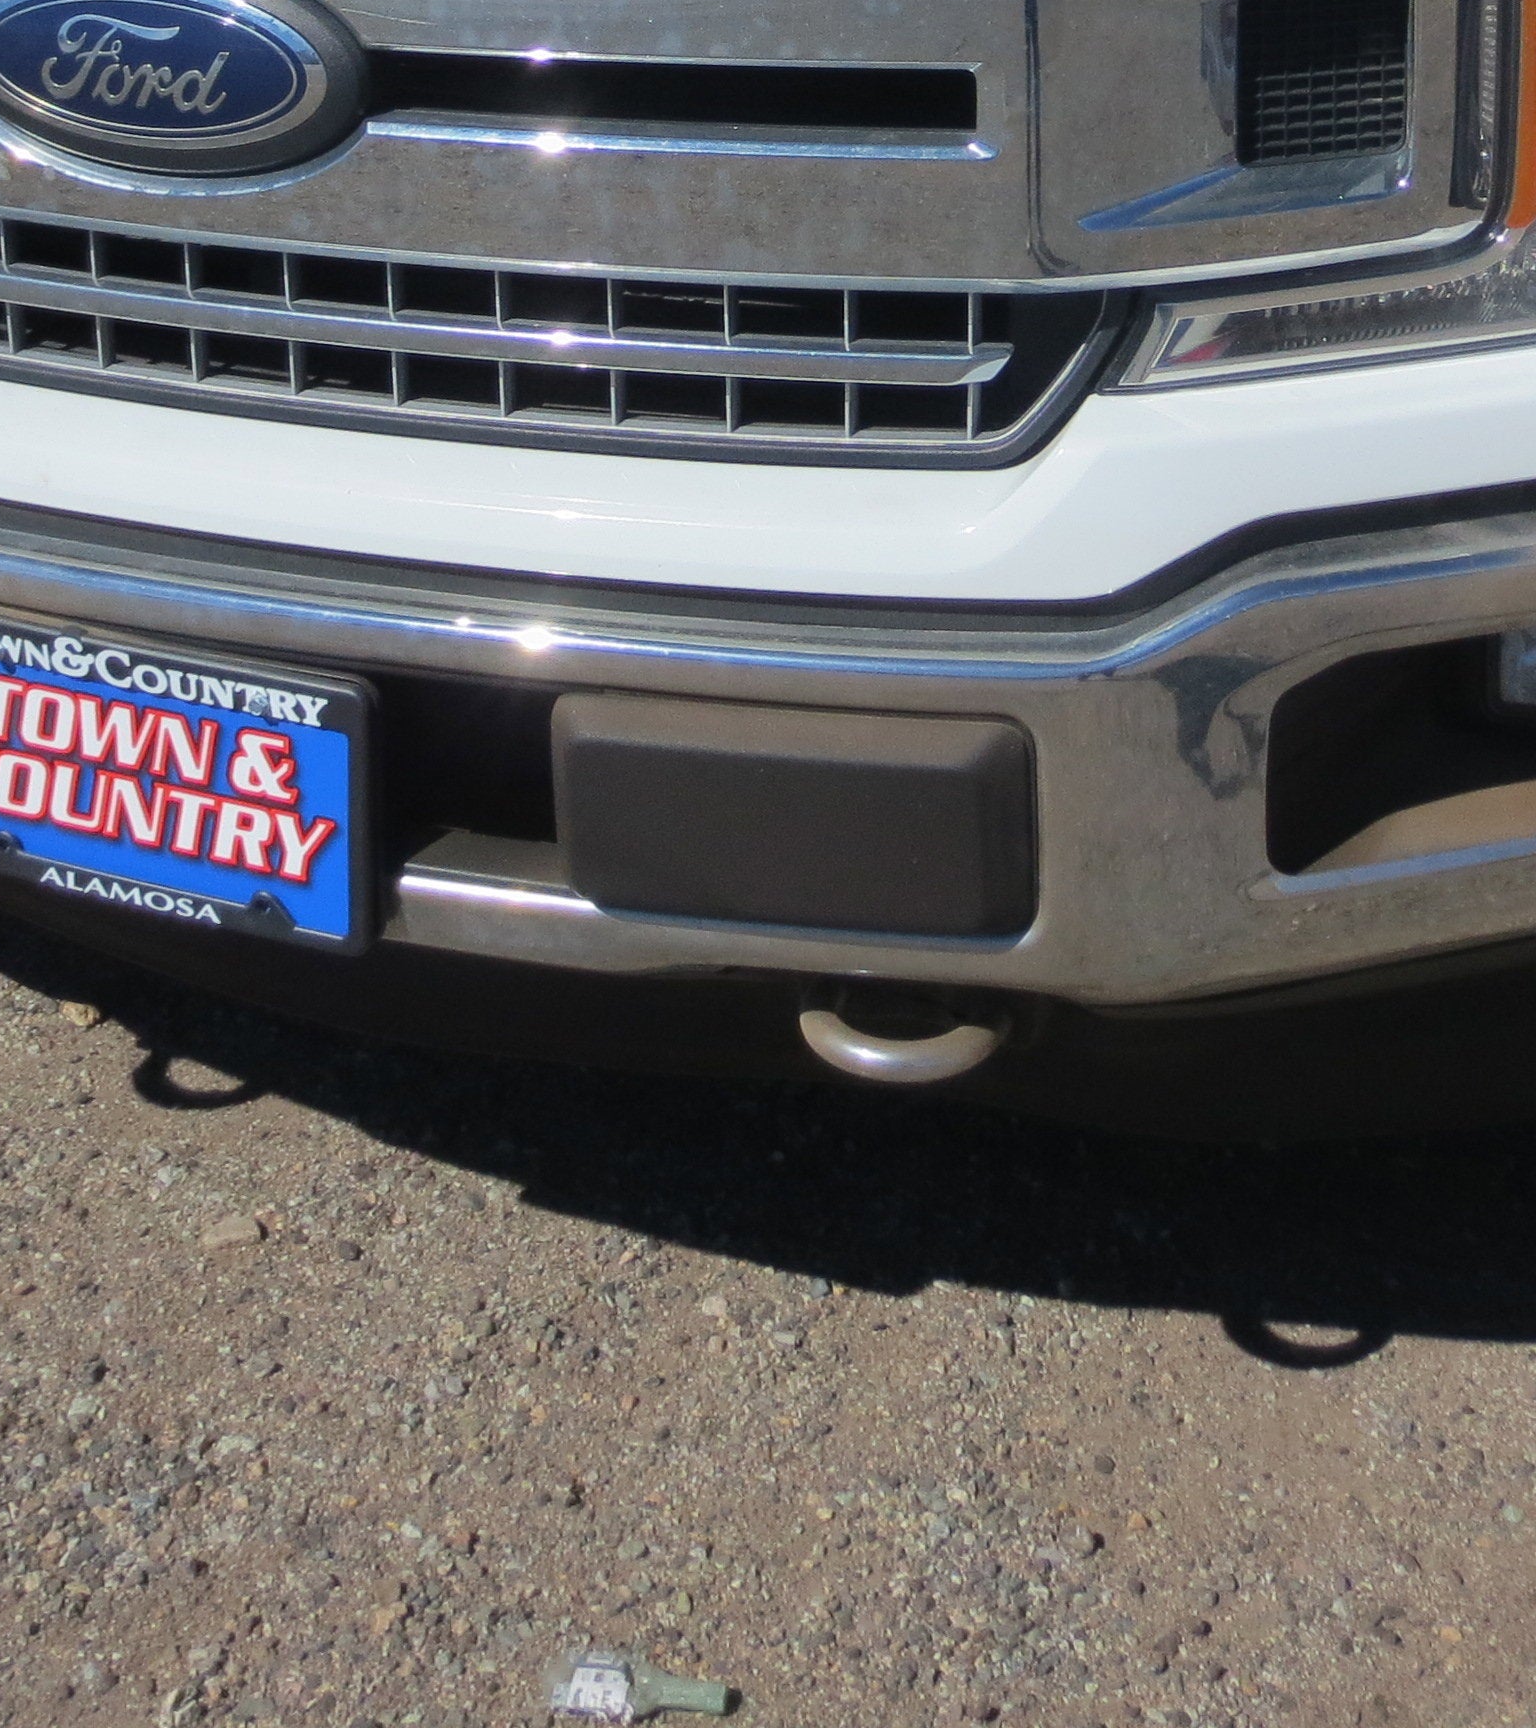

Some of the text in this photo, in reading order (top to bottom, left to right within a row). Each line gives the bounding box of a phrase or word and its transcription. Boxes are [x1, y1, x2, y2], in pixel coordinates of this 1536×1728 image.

[41, 13, 231, 114] Ford
[227, 727, 300, 804] &
[39, 866, 223, 926] ALAMOSA
